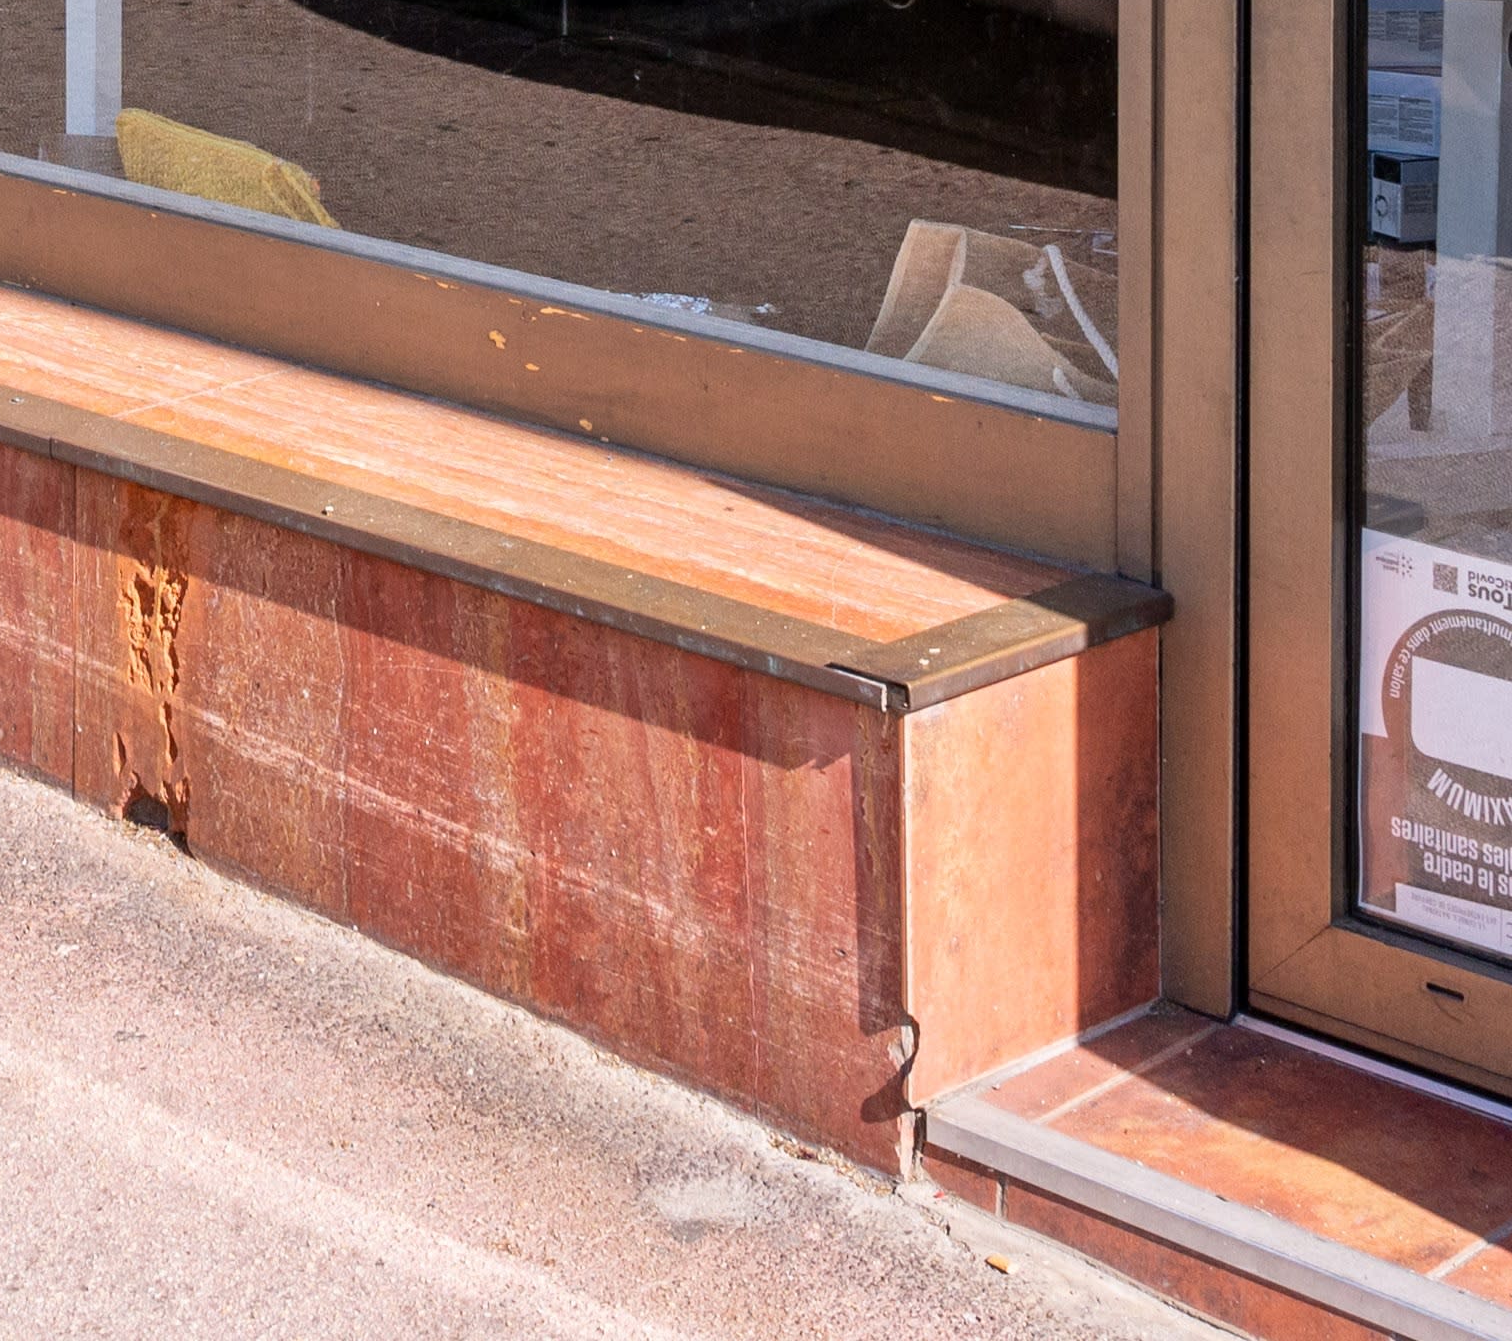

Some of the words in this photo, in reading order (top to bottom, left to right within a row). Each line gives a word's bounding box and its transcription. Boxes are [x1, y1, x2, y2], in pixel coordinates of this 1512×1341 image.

[1406, 627, 1431, 651] dans
[1398, 648, 1412, 664] ce
[1389, 663, 1404, 699] salon
[1391, 815, 1479, 861] sanitaires
[1423, 852, 1474, 885] cadre
[1478, 867, 1494, 897] le
